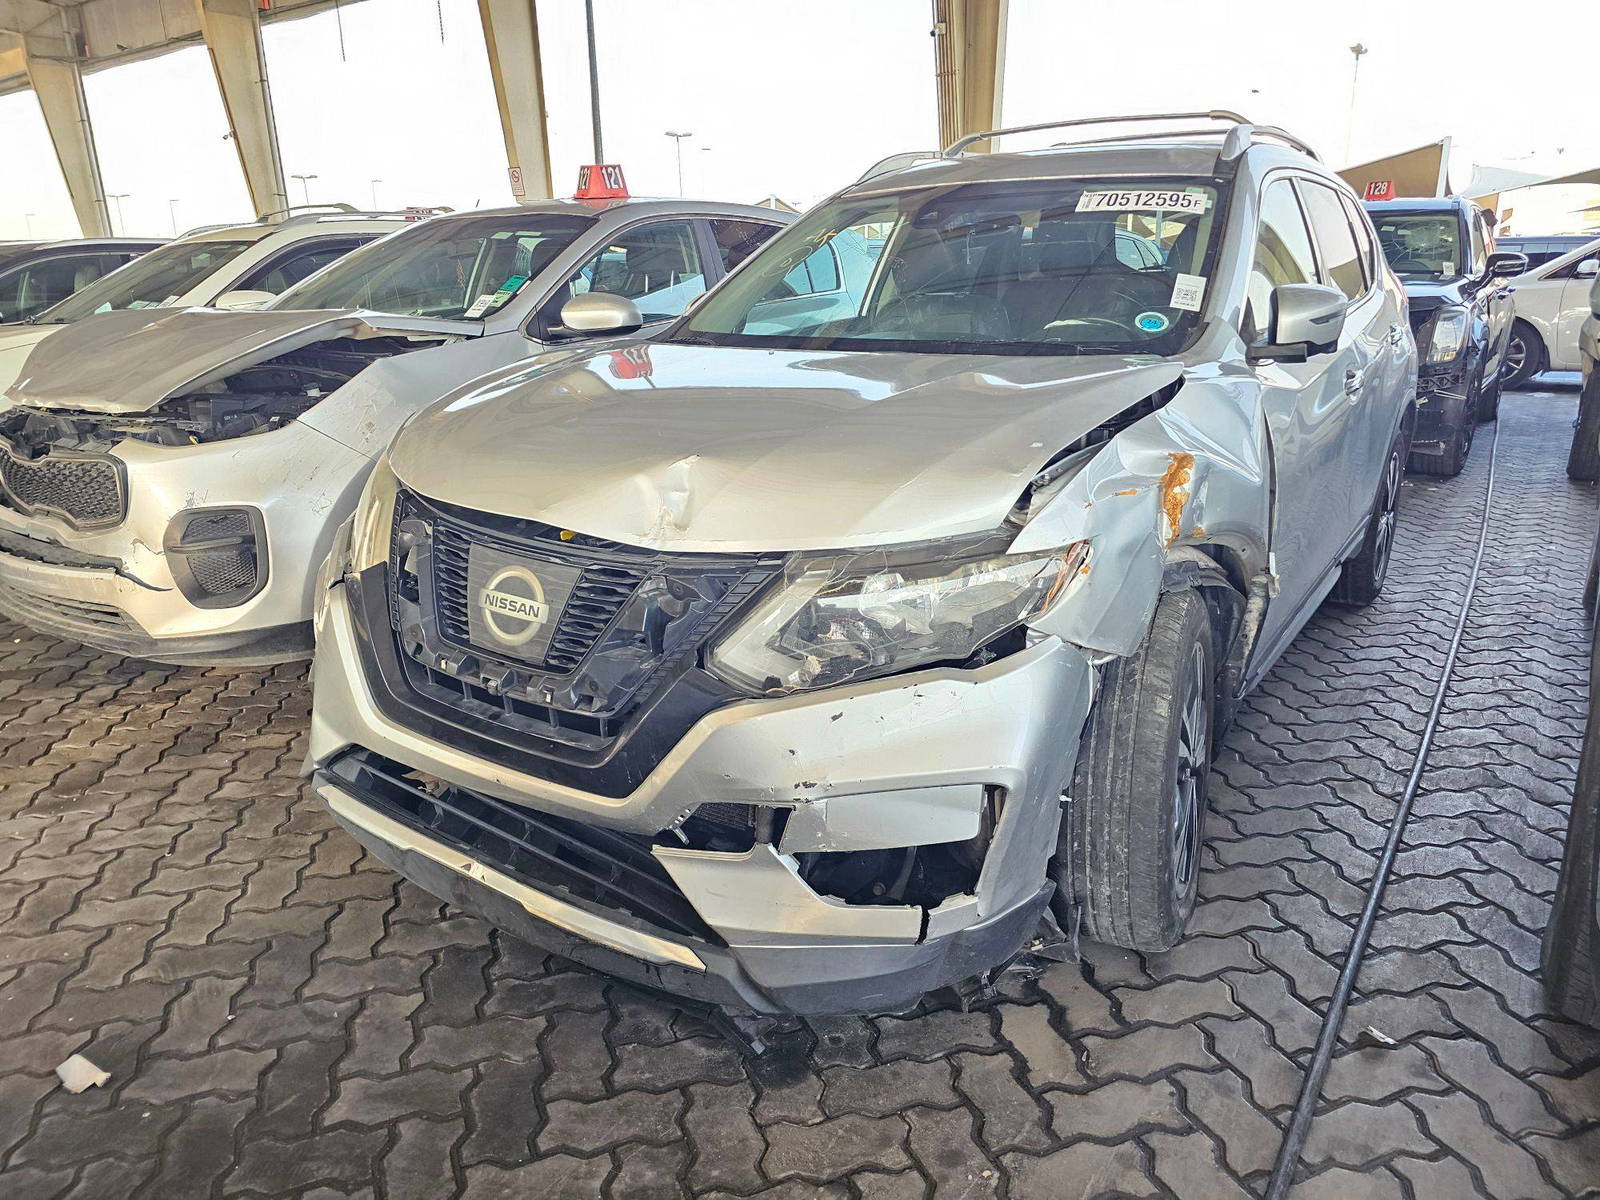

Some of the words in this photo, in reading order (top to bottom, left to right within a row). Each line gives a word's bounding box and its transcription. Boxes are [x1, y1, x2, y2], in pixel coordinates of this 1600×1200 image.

[601, 166, 624, 189] 121
[1369, 181, 1388, 195] 128
[484, 593, 540, 618] NISSAN
